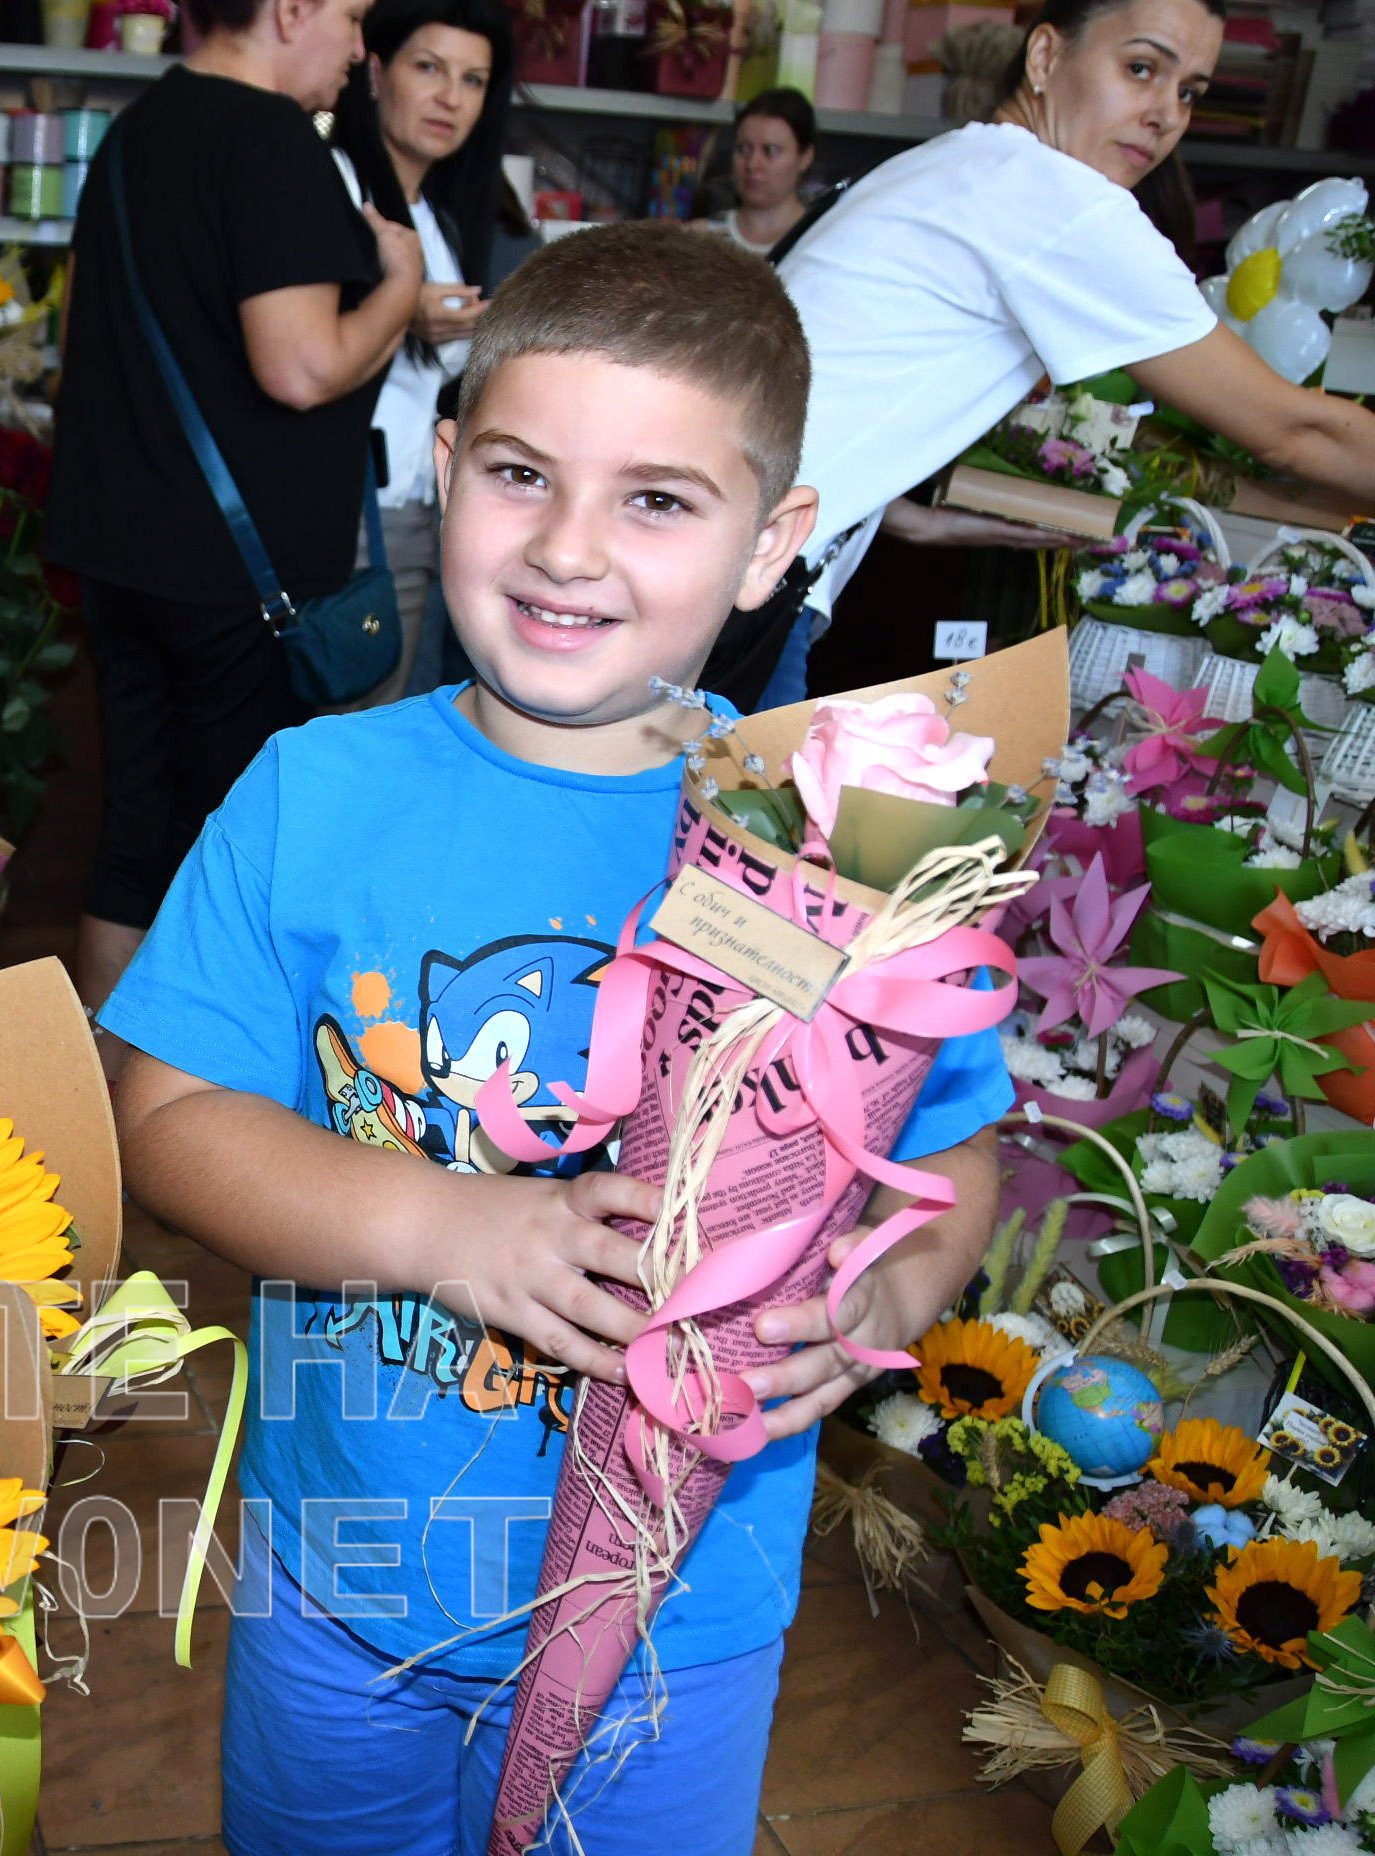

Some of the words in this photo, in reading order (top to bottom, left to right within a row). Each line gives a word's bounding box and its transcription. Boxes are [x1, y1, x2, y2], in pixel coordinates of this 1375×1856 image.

[693, 889, 730, 920] обич
[732, 917, 748, 929] и
[774, 1145, 816, 1165] hurricane
[727, 1182, 739, 1194] by
[738, 1168, 782, 1189] conditions
[780, 1182, 796, 1195] and
[729, 1182, 771, 1204] prediction
